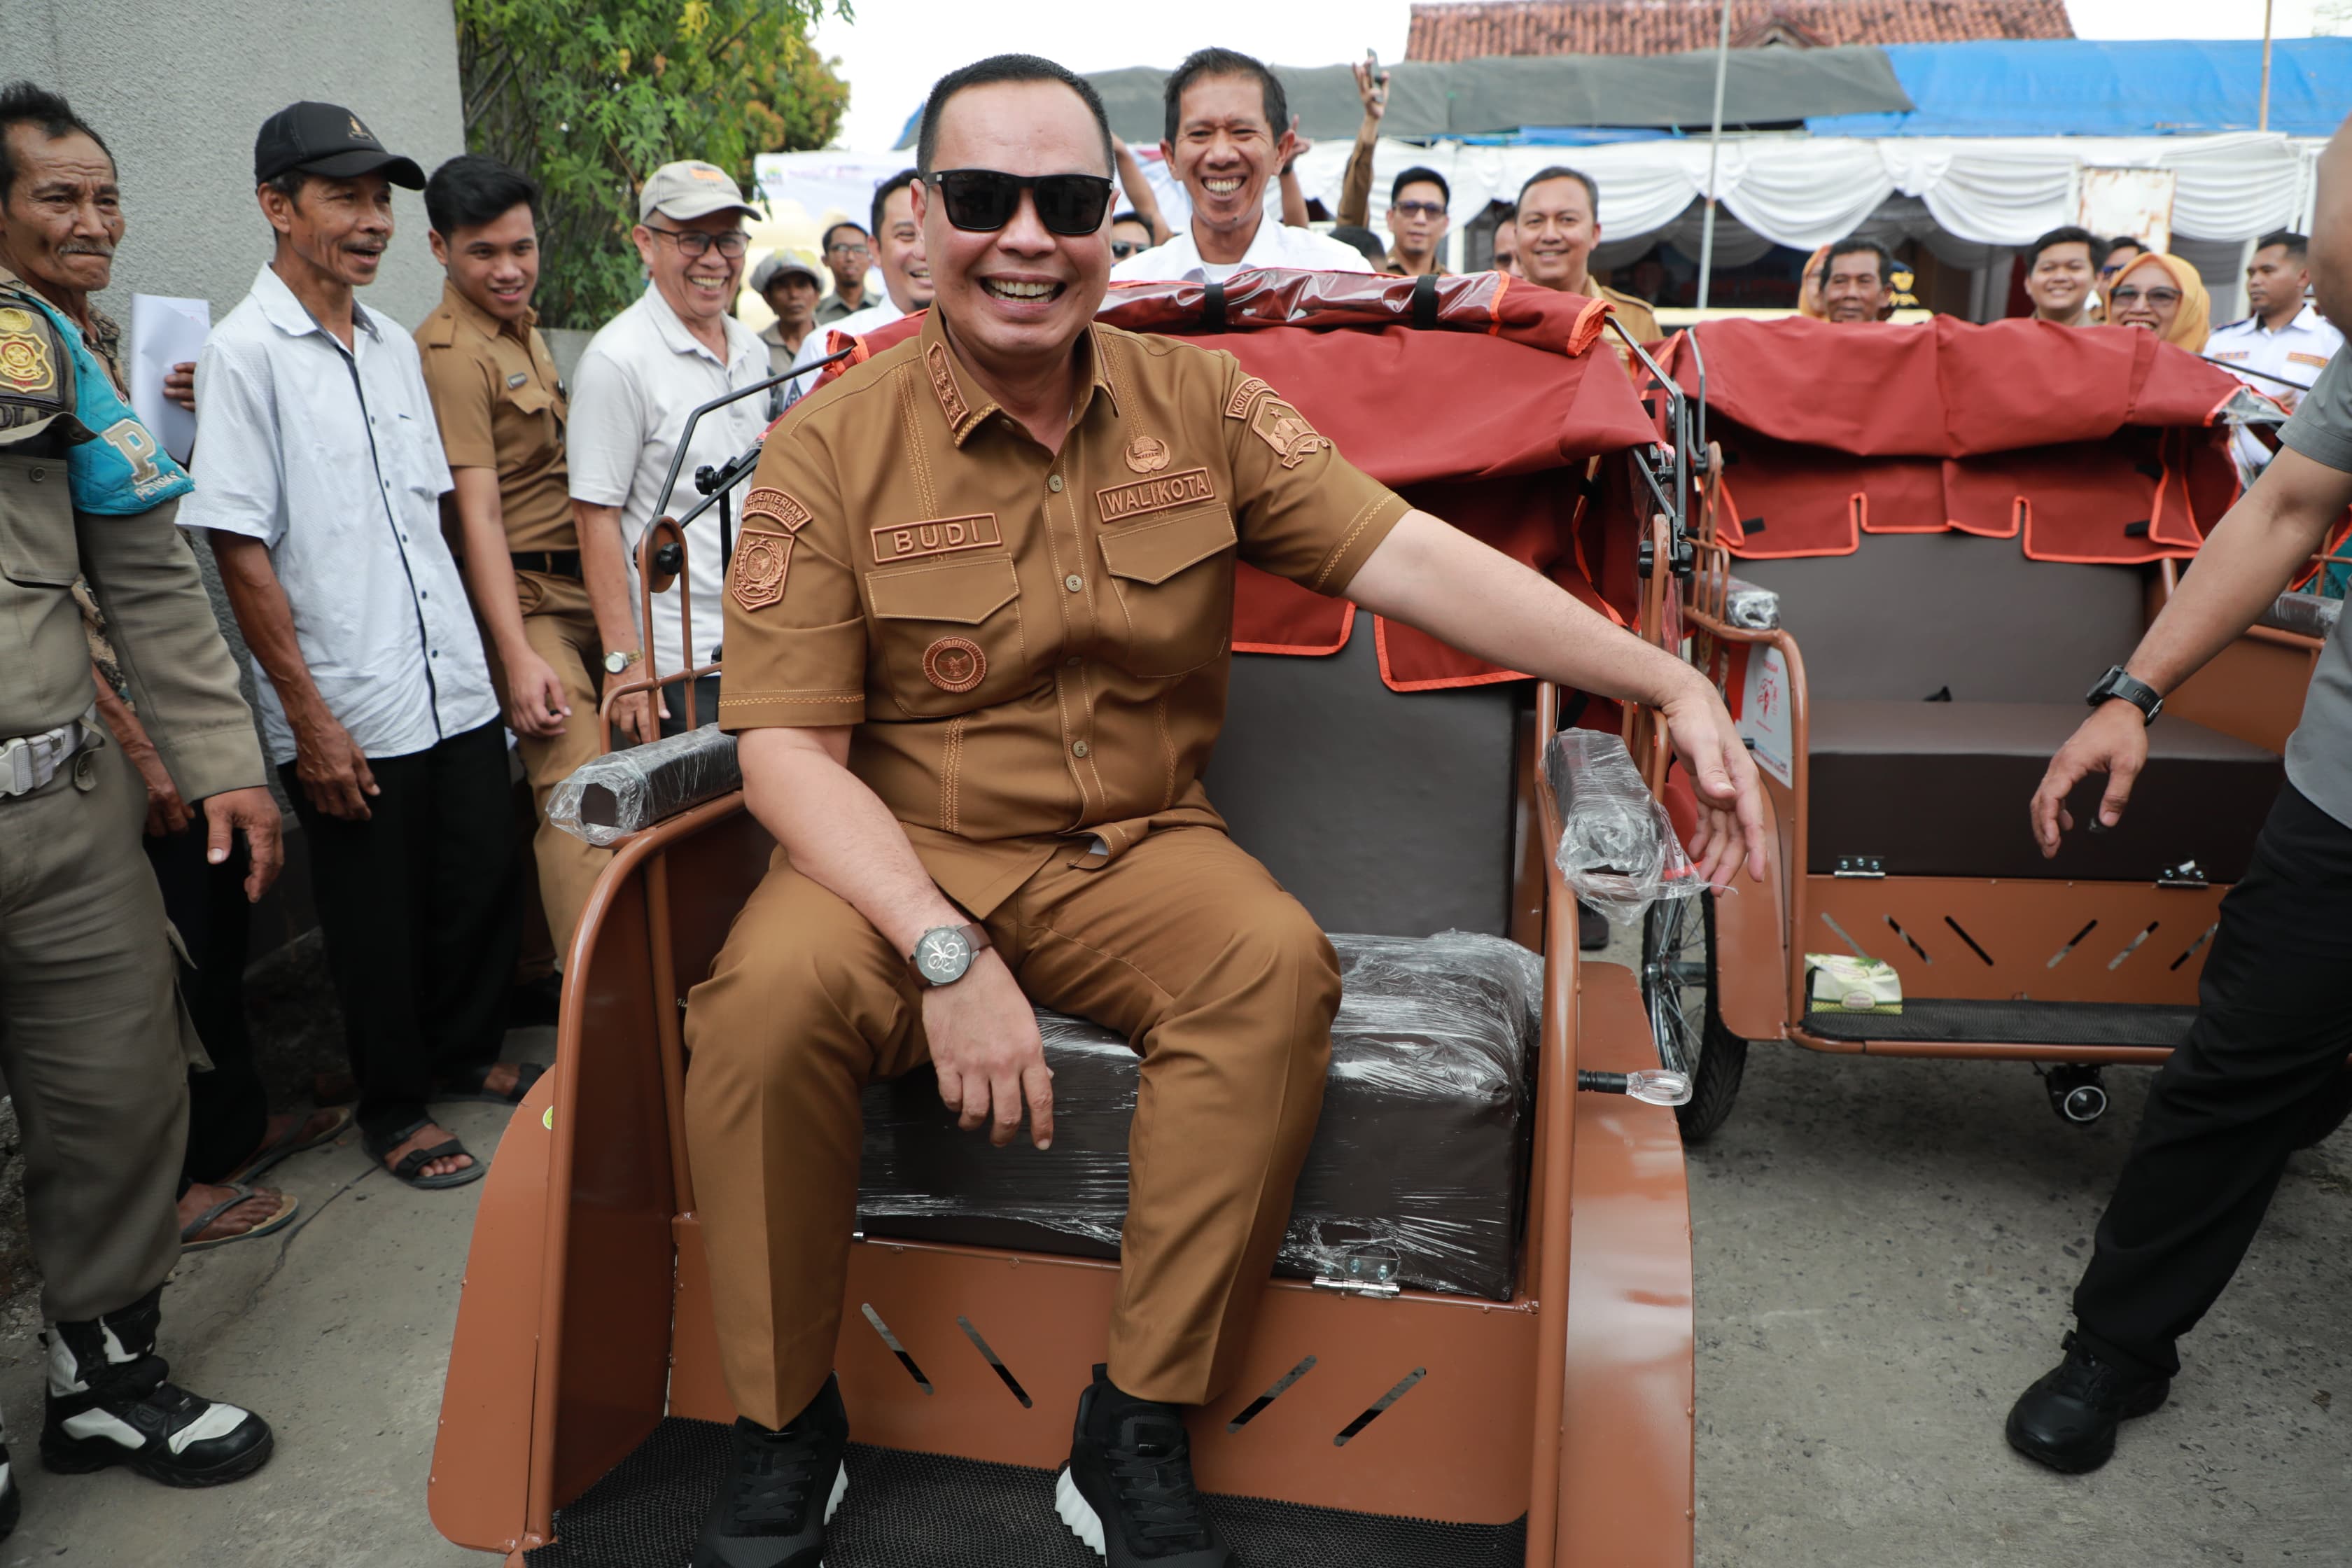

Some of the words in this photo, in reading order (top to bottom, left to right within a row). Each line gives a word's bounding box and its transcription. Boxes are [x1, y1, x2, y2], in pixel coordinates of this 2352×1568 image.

[1231, 391, 1251, 414] KOTA
[100, 418, 160, 485] P
[1105, 474, 1208, 514] WALIKOTA
[892, 519, 980, 554] BUDI
